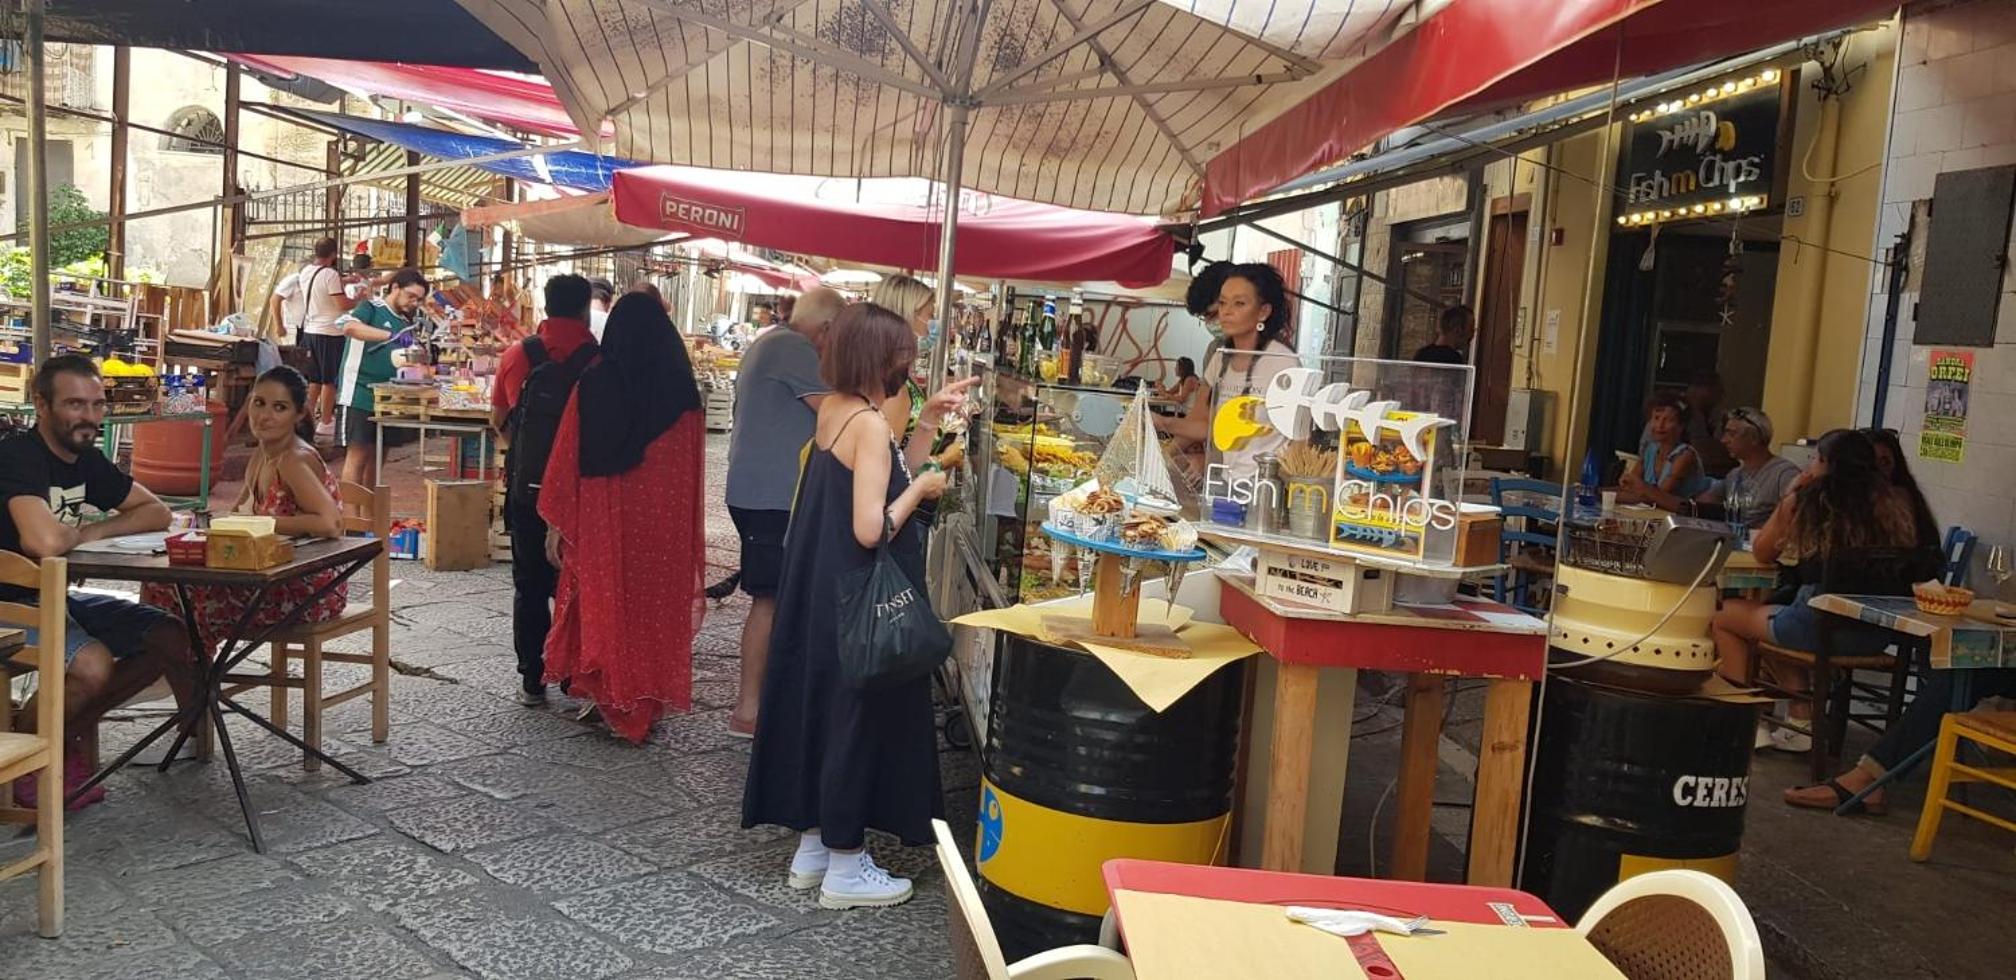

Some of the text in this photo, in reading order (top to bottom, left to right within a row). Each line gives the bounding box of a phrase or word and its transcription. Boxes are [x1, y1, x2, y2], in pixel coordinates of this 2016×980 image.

[1671, 169, 1697, 195] m
[665, 200, 740, 231] PERONI
[1930, 366, 1971, 382] ORFEI
[1205, 463, 1456, 537] Fish m Chips
[1301, 559, 1319, 571] LOVE
[1296, 584, 1318, 599] BEACH
[1673, 775, 1749, 807] CERES
